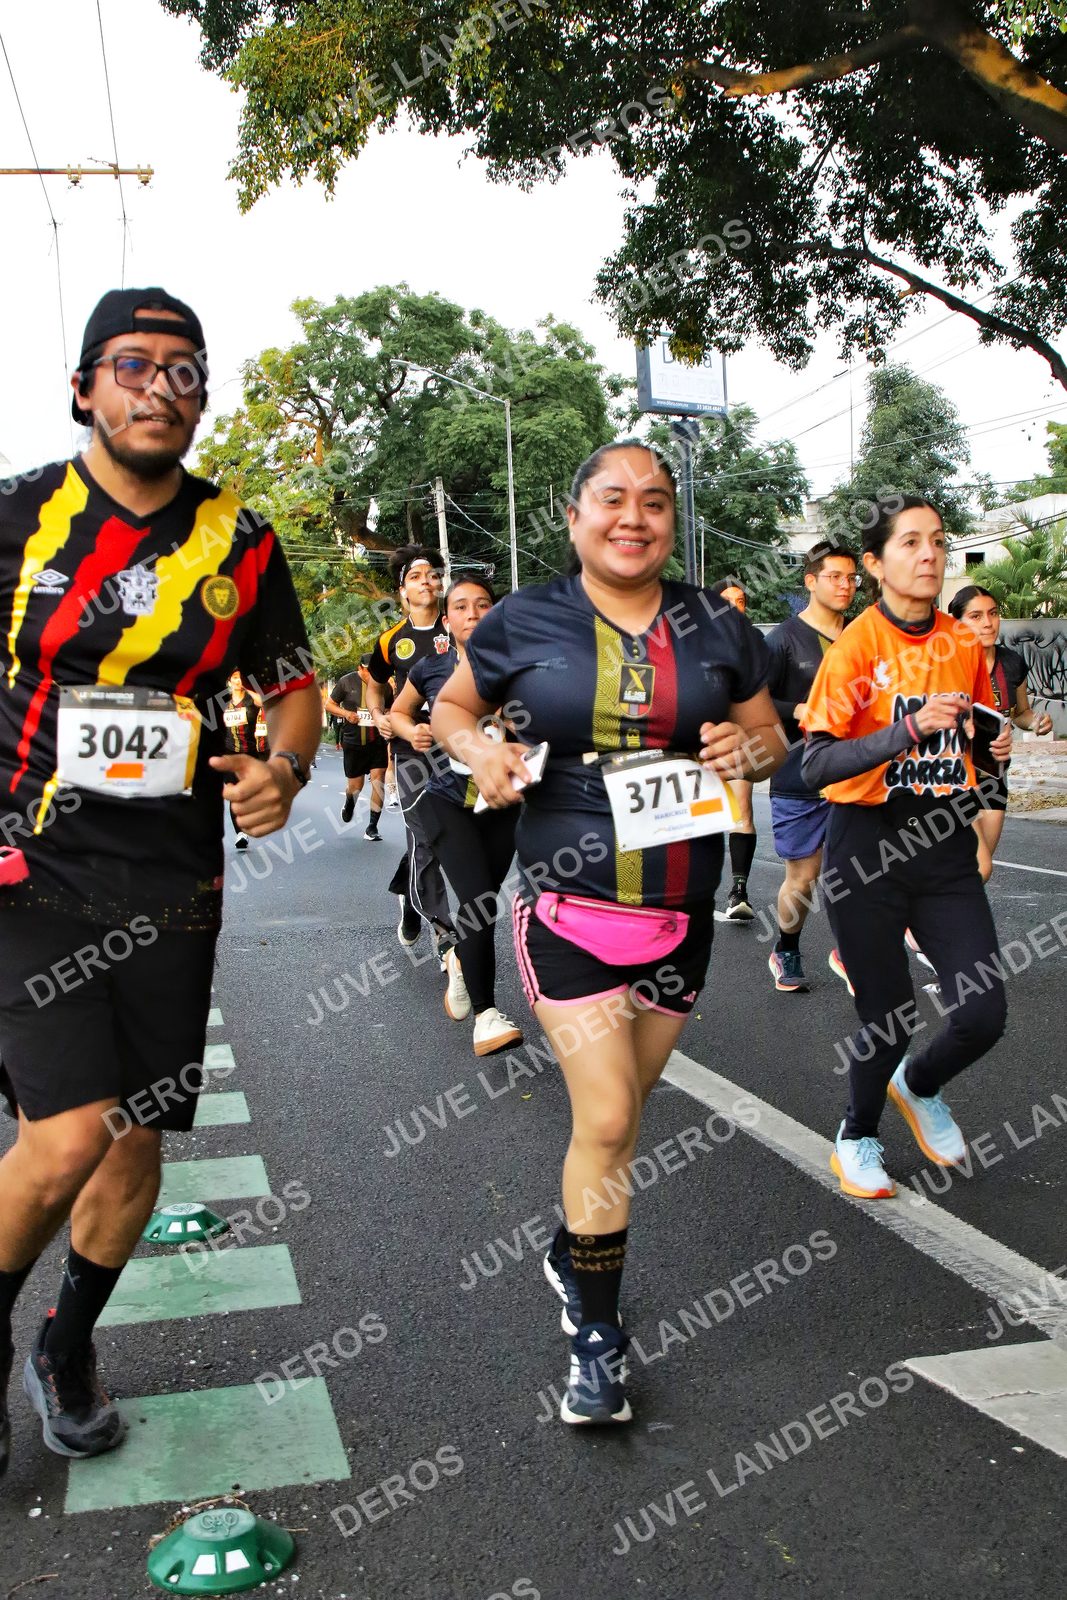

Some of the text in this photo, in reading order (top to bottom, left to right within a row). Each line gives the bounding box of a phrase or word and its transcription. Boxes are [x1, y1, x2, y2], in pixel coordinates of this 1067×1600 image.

[33, 586, 65, 595] umbro
[360, 713, 373, 721] 373
[77, 723, 169, 760] 3042
[625, 768, 703, 814] 3717
